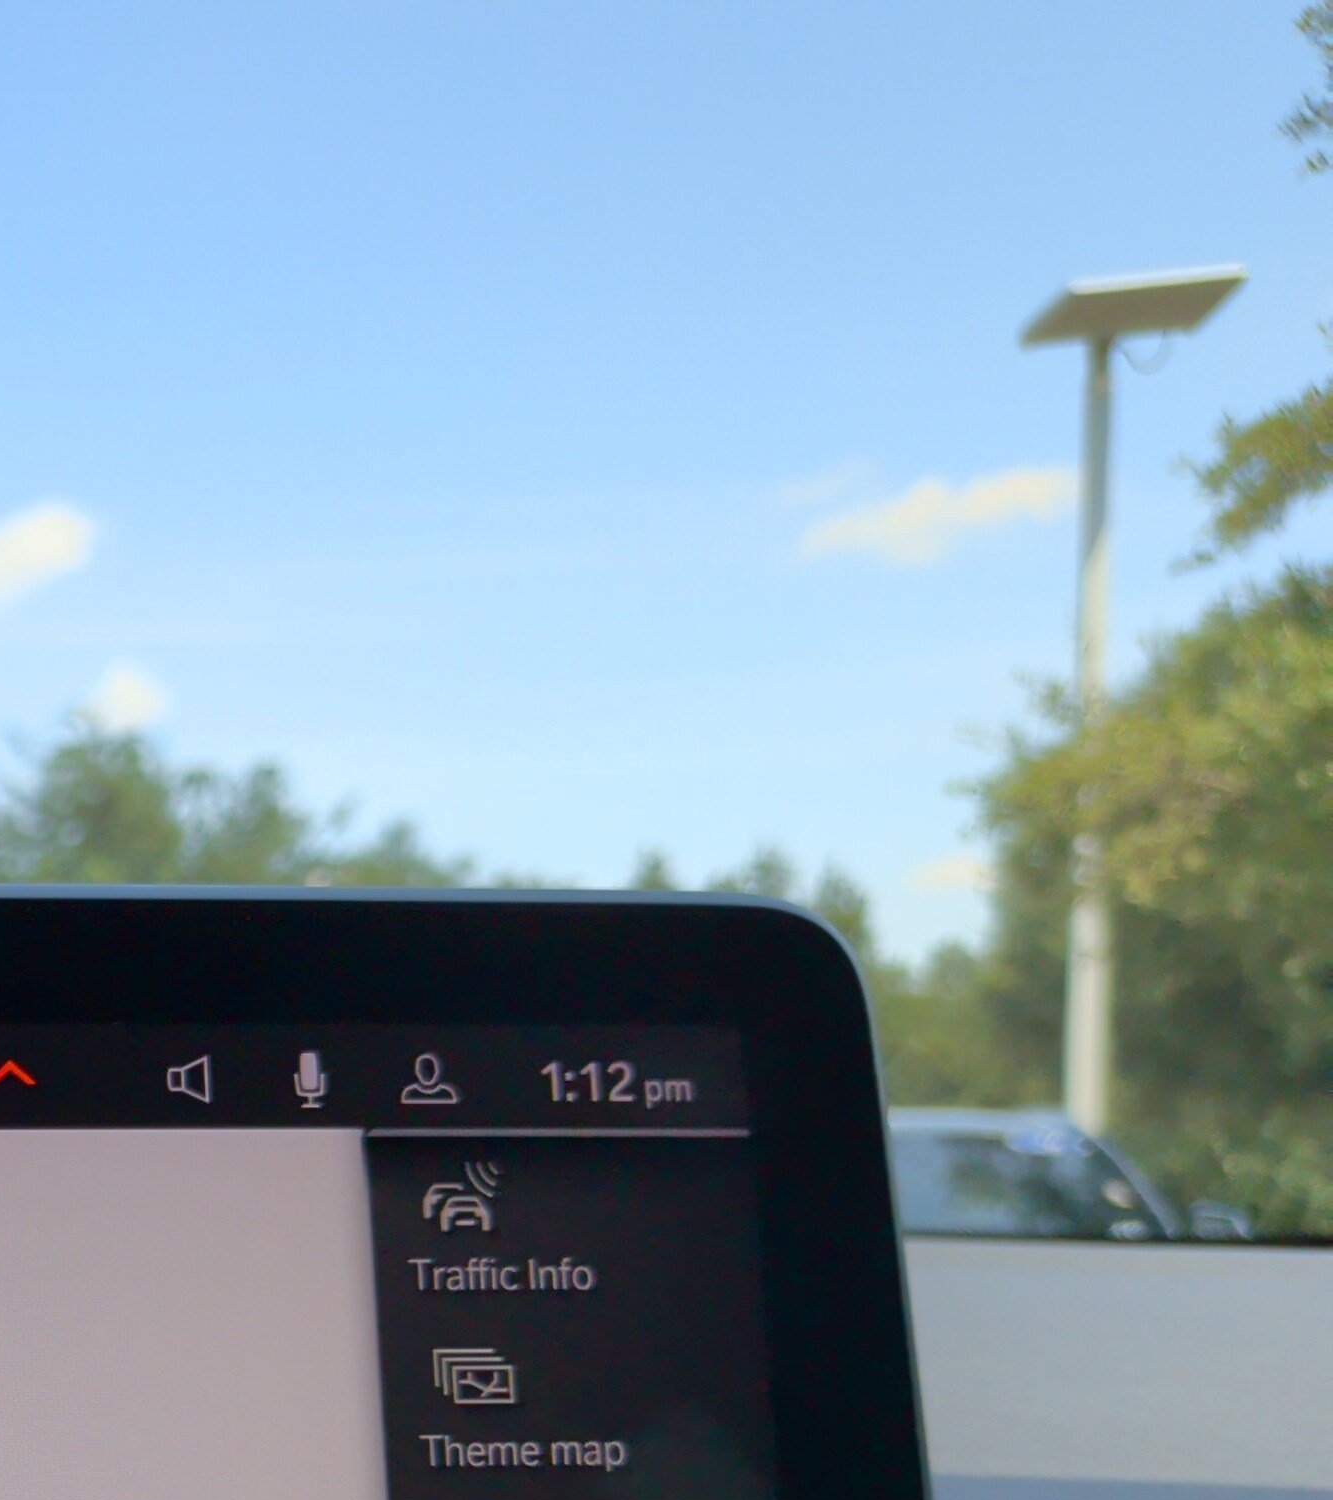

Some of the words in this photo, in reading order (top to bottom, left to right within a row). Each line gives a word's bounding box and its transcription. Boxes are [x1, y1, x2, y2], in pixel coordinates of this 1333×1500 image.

[539, 1060, 635, 1103] 1:12
[643, 1076, 695, 1108] pm
[408, 1257, 520, 1292] Traffic
[528, 1257, 595, 1291] Info
[419, 1434, 541, 1468] Theme
[549, 1440, 627, 1472] map
